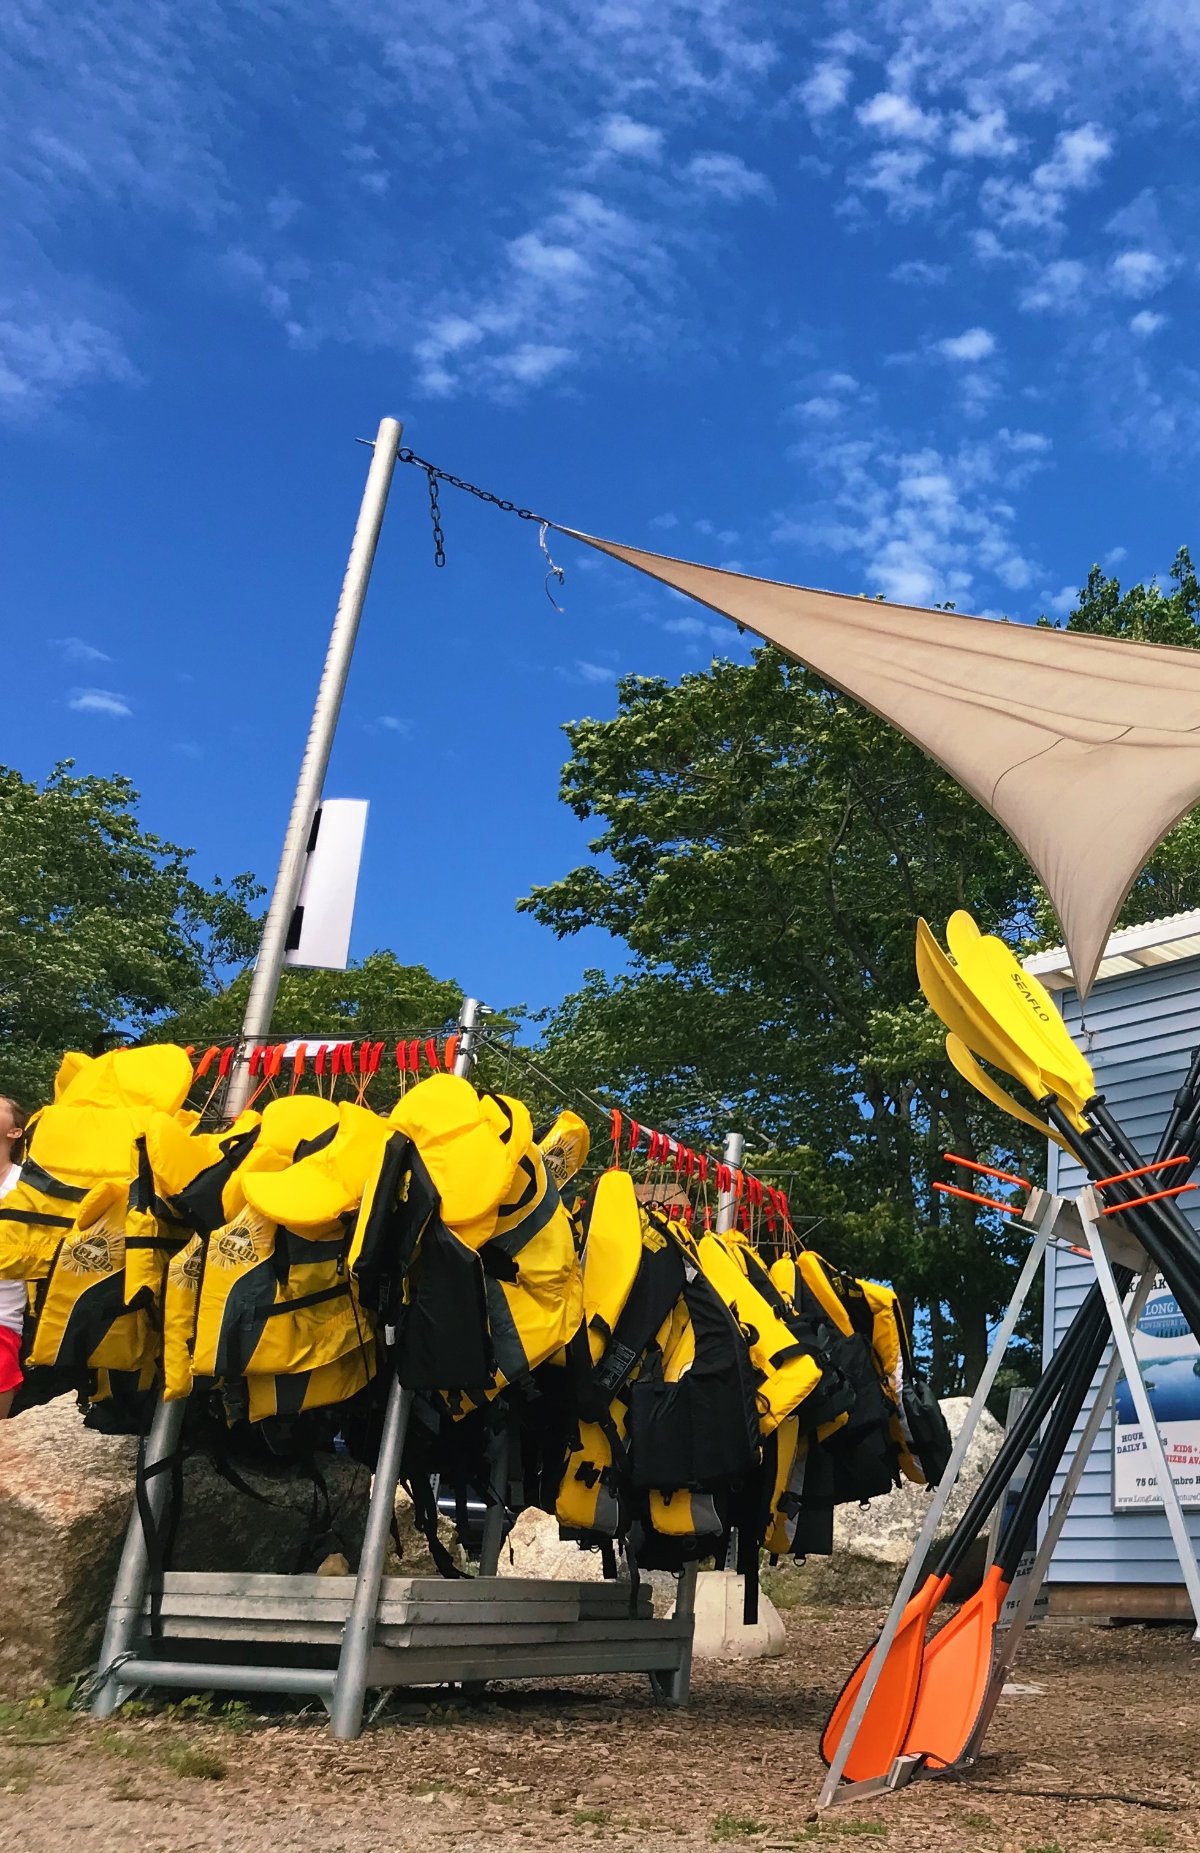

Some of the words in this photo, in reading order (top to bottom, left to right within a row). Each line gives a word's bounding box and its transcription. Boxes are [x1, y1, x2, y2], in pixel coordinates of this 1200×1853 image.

[1010, 973, 1050, 1022] SEAFLO
[223, 1237, 259, 1263] FLUID
[77, 1247, 114, 1272] FLUID
[1145, 1301, 1175, 1316] LONG
[1116, 1443, 1140, 1454] DAILY
[1173, 1445, 1193, 1454] KIDS
[1136, 1478, 1146, 1487] 75
